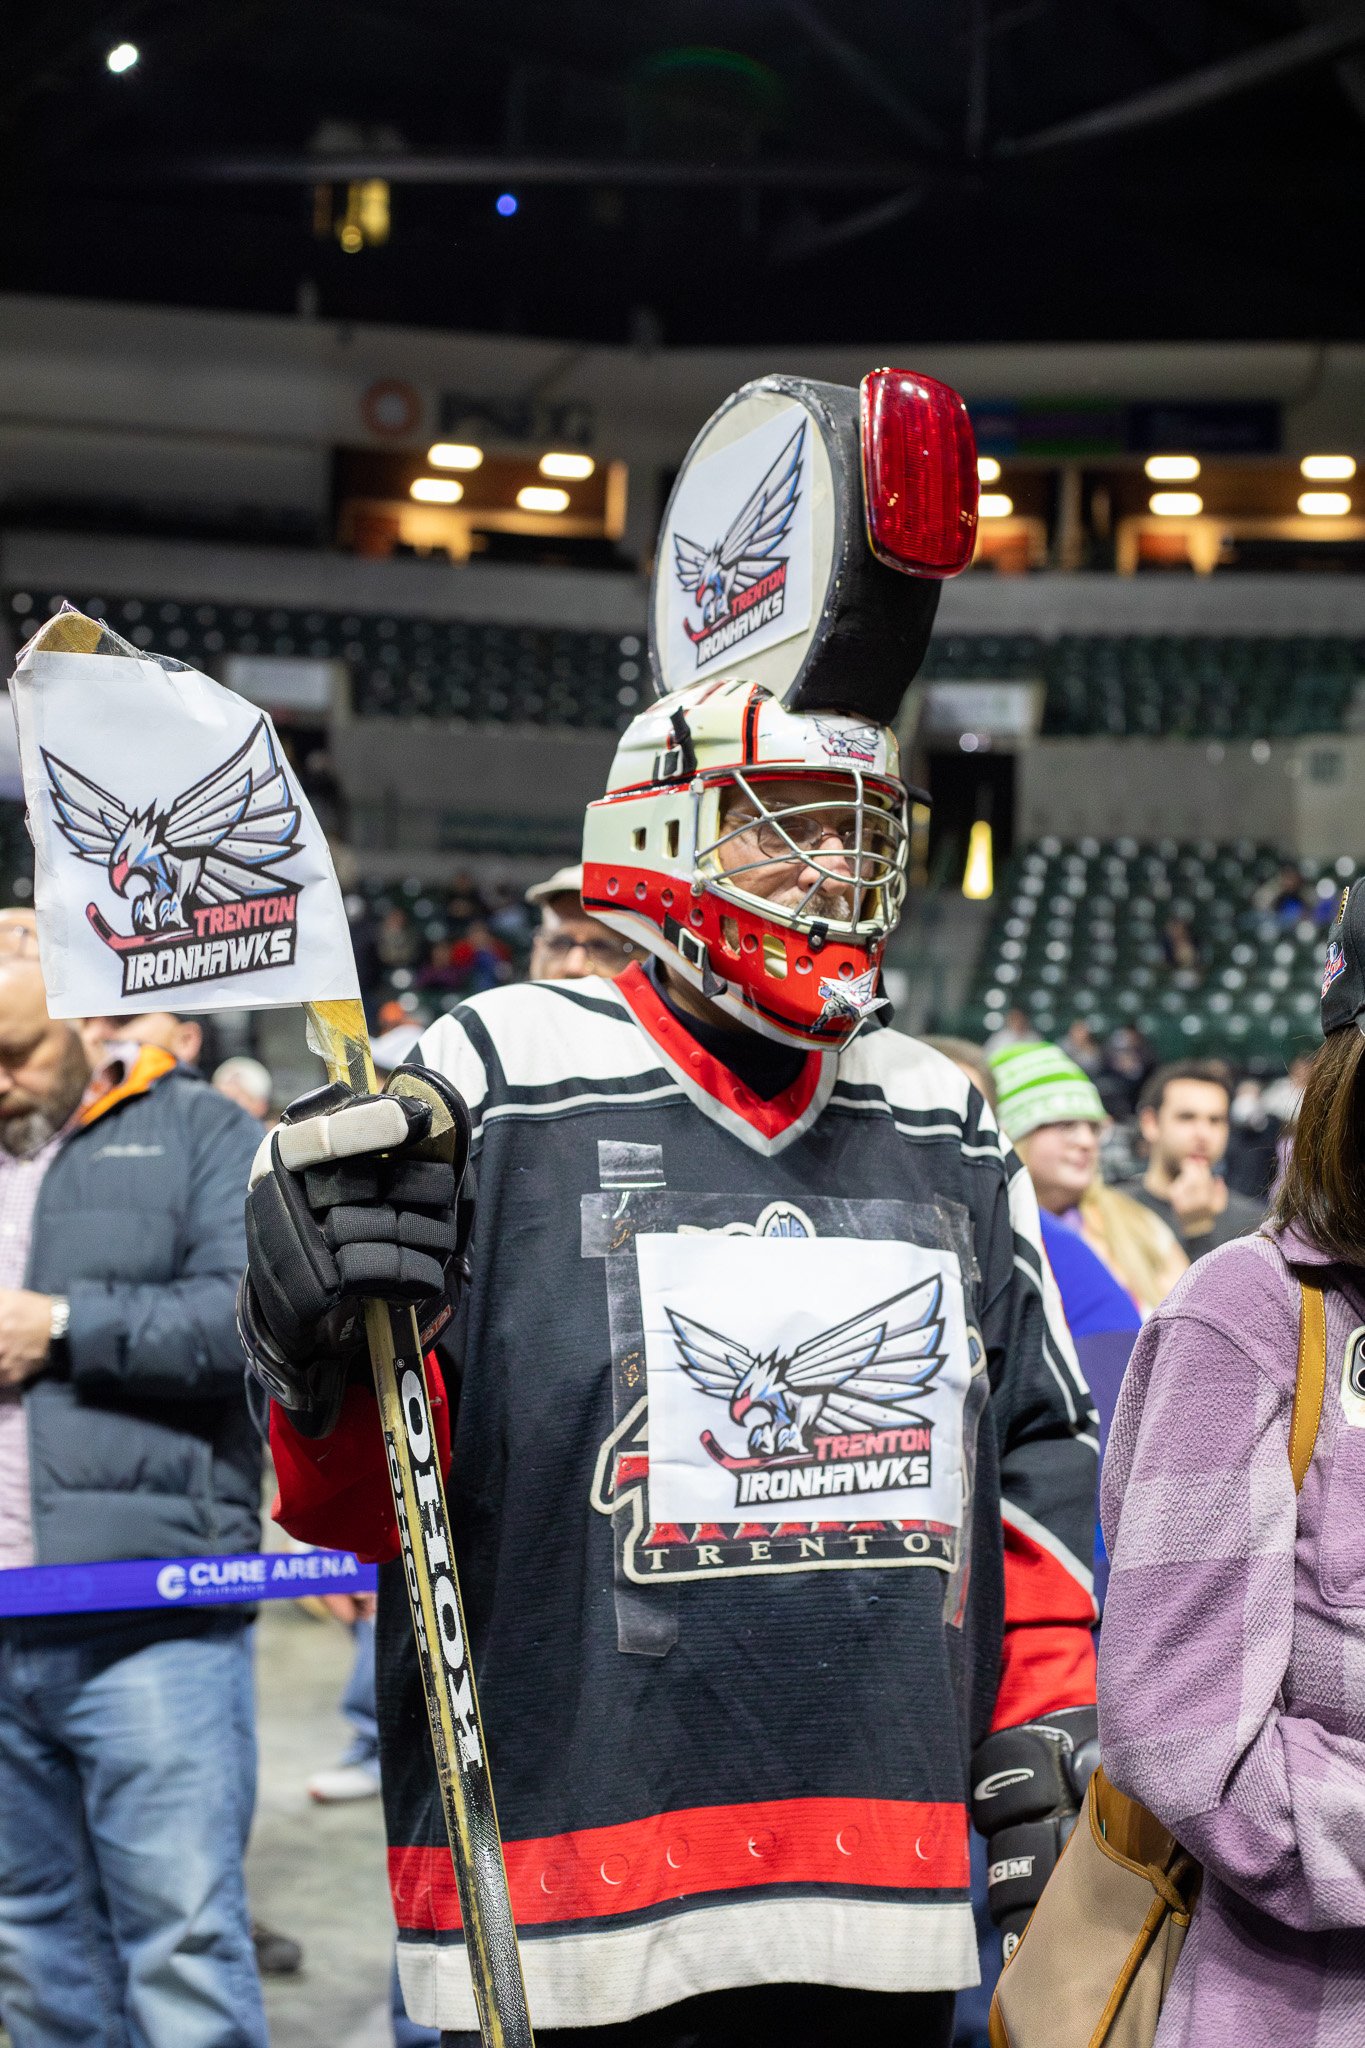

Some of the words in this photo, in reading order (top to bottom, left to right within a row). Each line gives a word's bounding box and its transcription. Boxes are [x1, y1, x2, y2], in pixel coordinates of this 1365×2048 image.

[731, 563, 787, 618] TRENTON
[698, 588, 784, 666] IRONHAWKS
[193, 894, 297, 937] TRENTON
[126, 927, 293, 991] IRONHAWKS
[813, 1427, 931, 1462] TRENTON
[738, 1455, 930, 1503] IRONHAWKS
[188, 1559, 267, 1587] CURE
[270, 1554, 359, 1581] ARENA
[401, 1369, 483, 1772] KOHO
